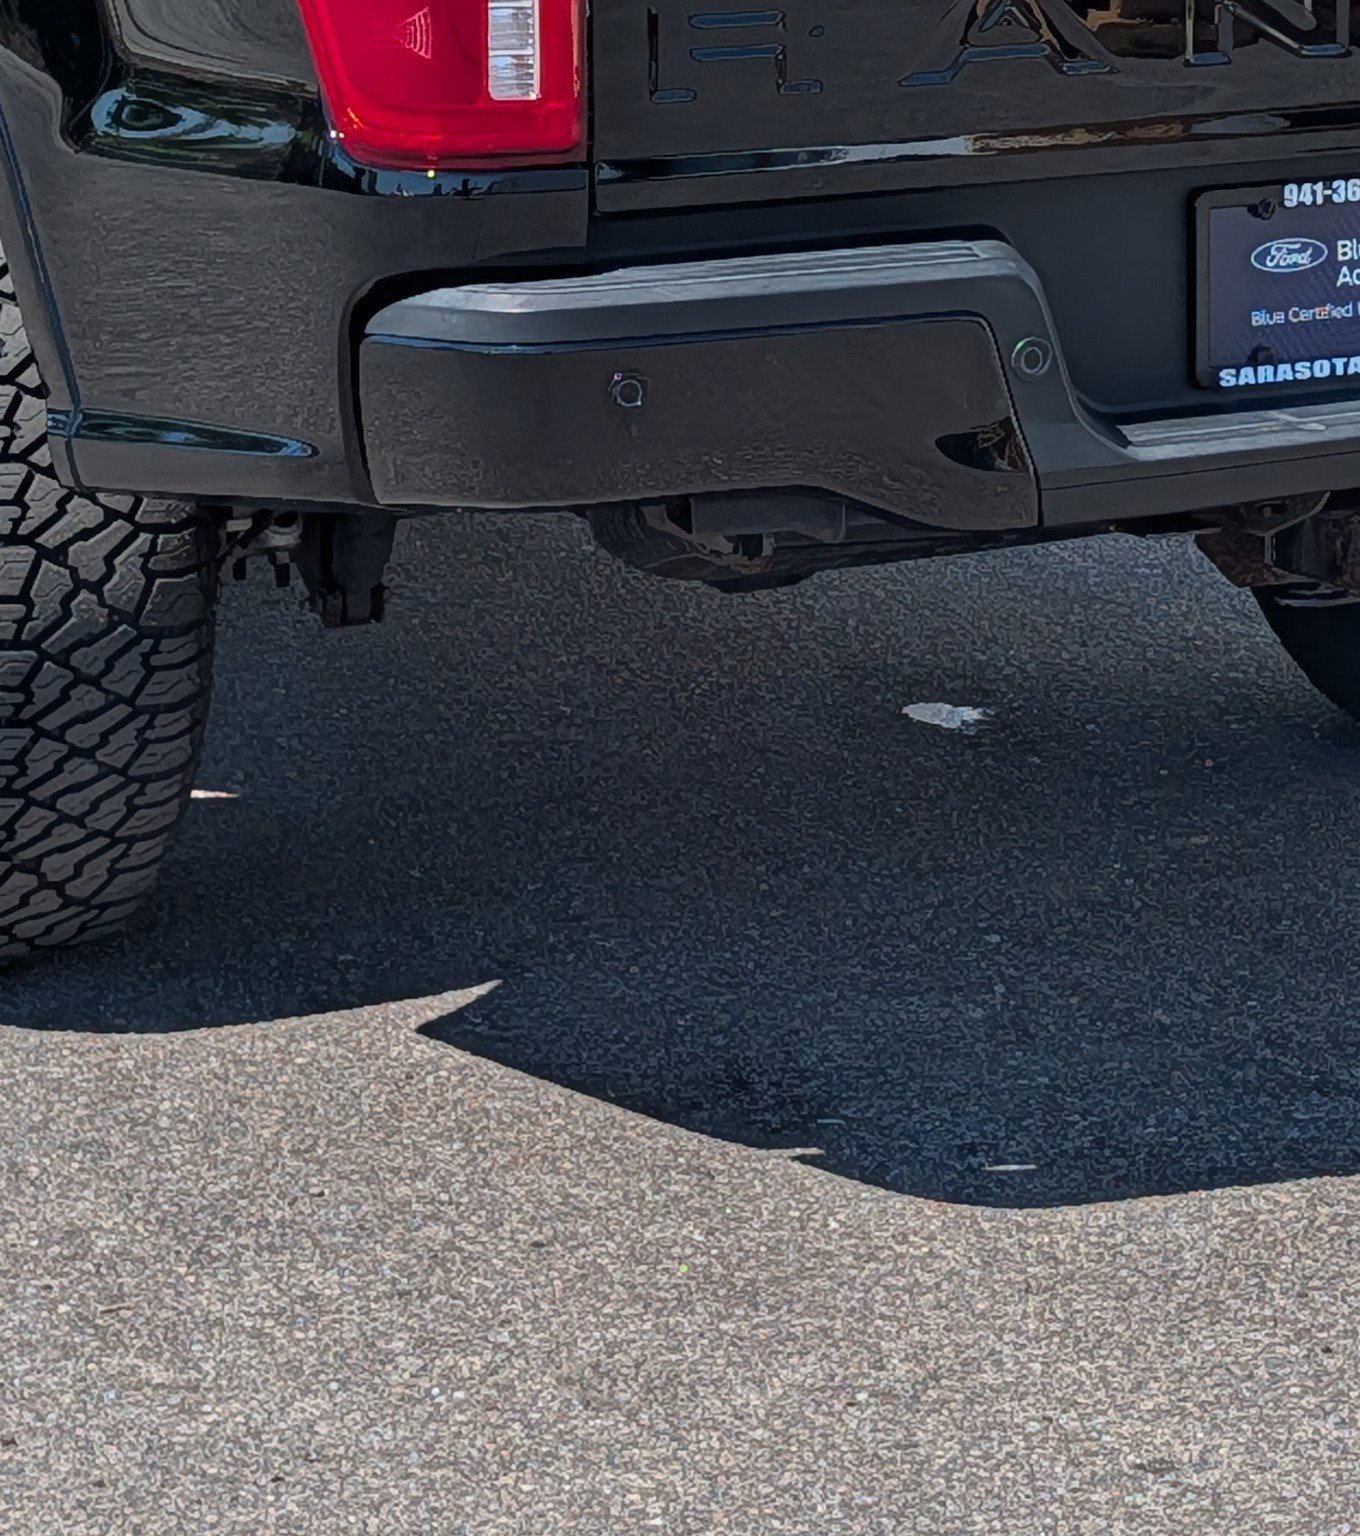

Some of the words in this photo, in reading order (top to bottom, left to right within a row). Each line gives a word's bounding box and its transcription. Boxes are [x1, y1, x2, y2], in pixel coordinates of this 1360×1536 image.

[1264, 242, 1314, 269] Ford
[1250, 310, 1286, 327] Blue
[1288, 301, 1353, 324] Certified
